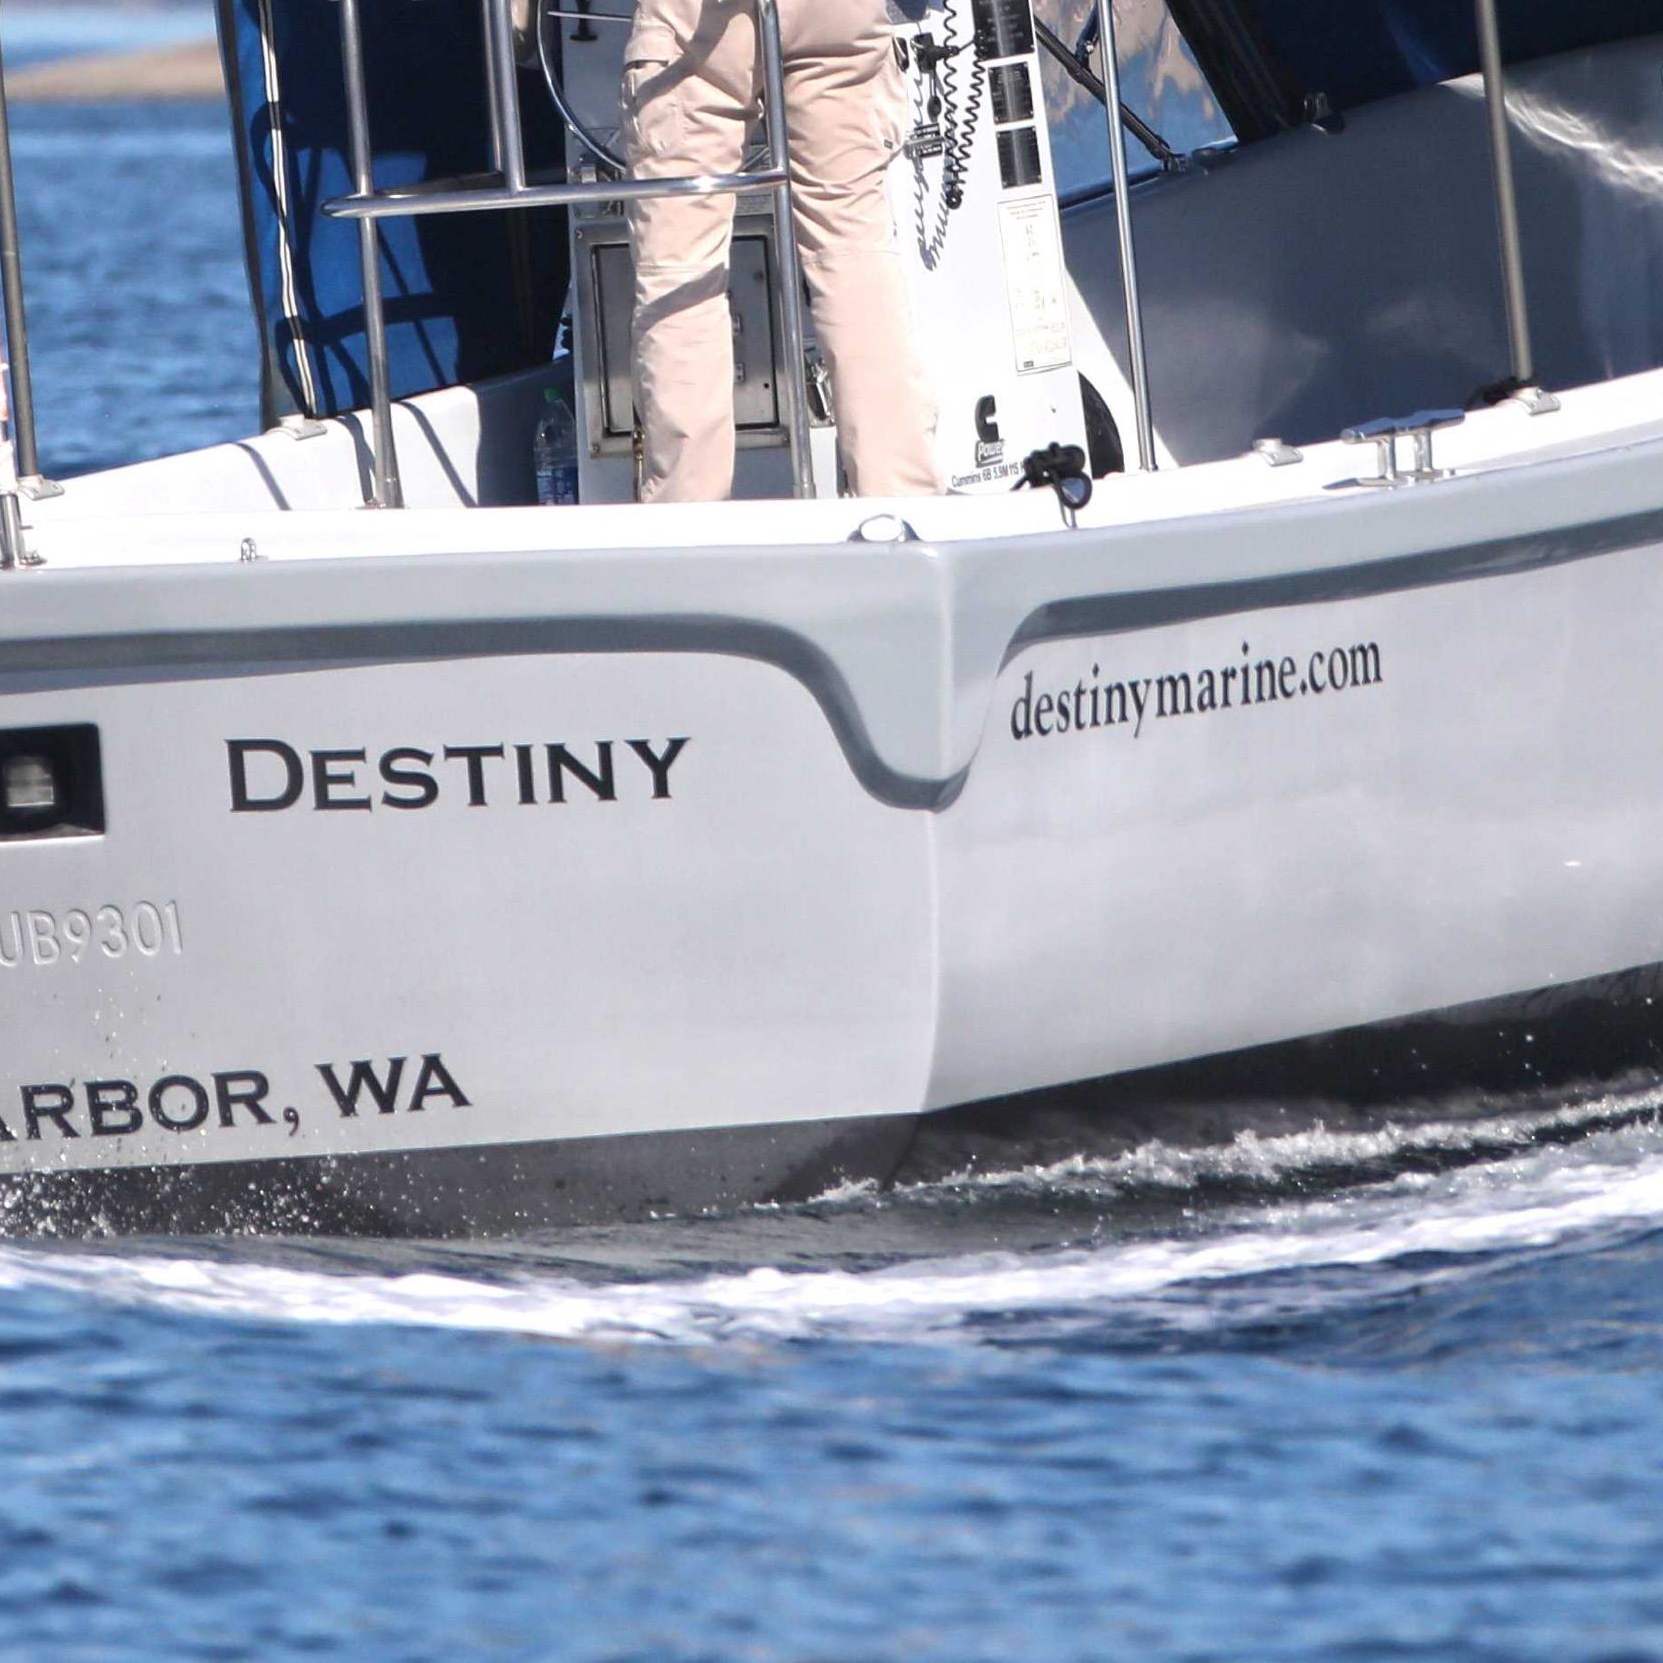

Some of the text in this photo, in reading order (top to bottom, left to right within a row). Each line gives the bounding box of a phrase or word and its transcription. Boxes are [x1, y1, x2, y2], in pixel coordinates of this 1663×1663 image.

[1010, 640, 1383, 739] destinymarine.com
[223, 736, 692, 813] DESTINY
[313, 1051, 474, 1118] WA
